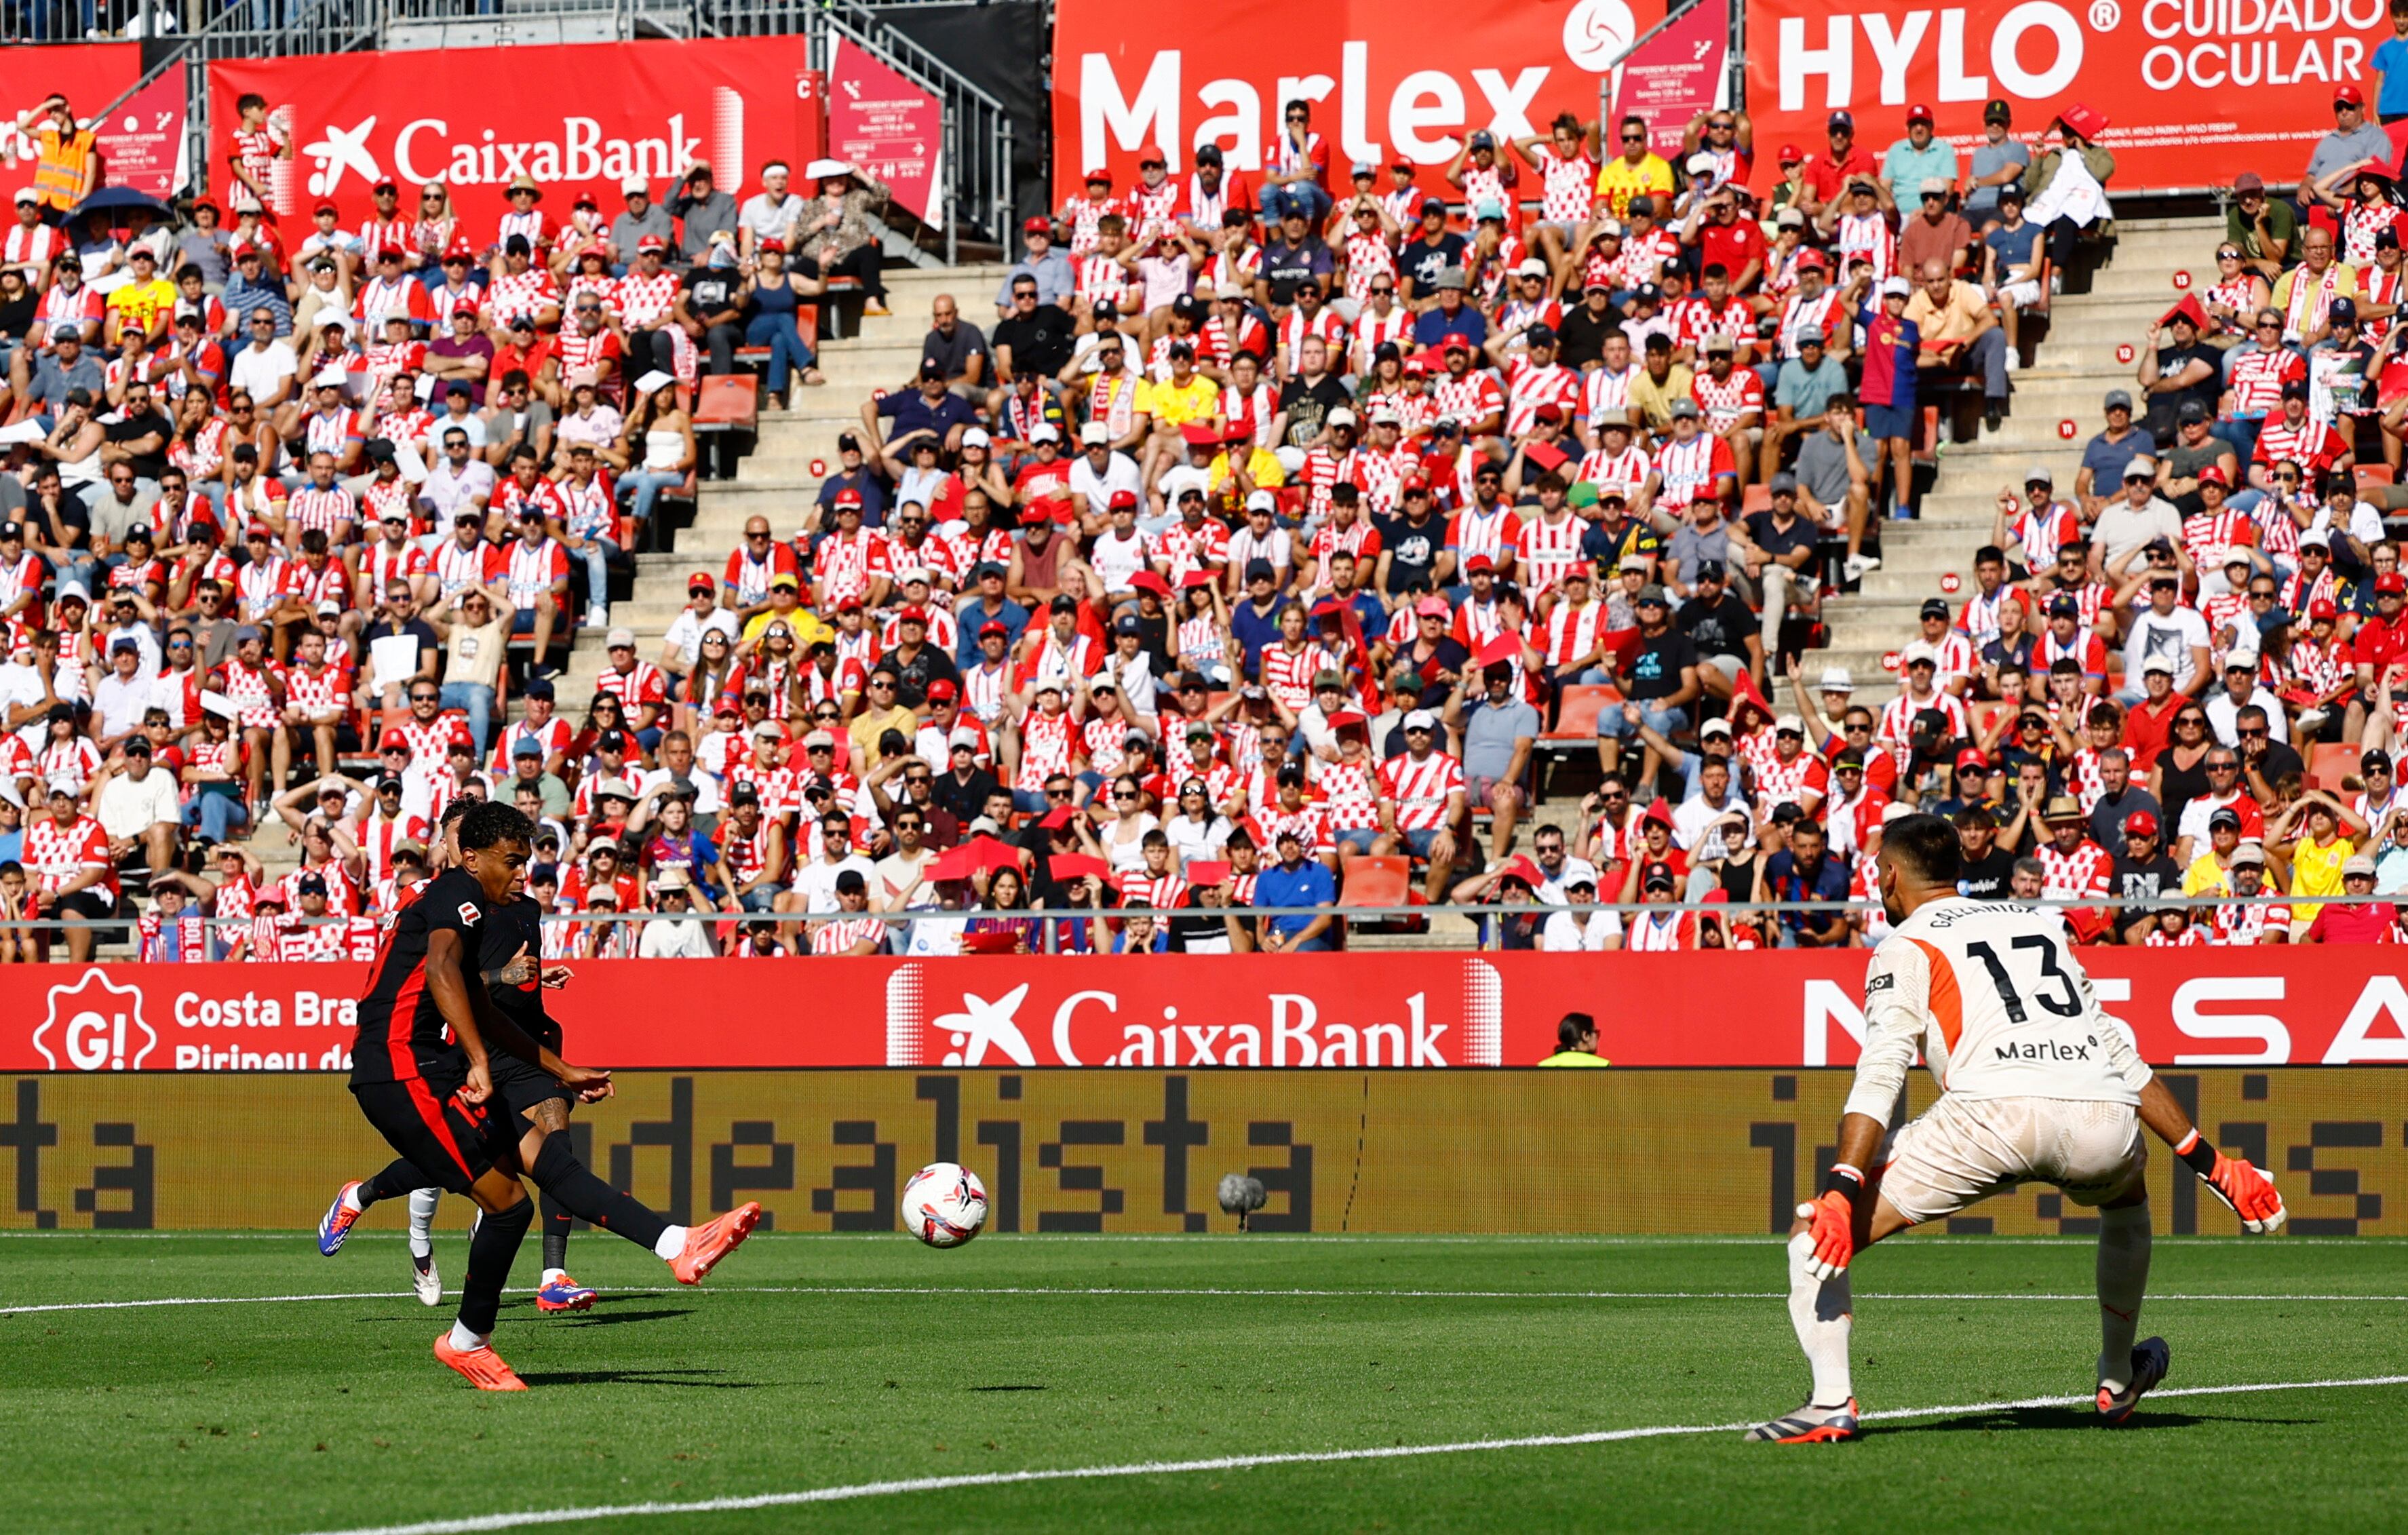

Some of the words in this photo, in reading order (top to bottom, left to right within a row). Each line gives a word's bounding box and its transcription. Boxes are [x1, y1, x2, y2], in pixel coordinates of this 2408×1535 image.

[2141, 0, 2384, 39] CUIDADO
[2141, 37, 2363, 91] OCULAR
[797, 79, 811, 99] C
[1081, 40, 1552, 178] Marlex
[394, 113, 703, 185] CaixaBank
[2200, 133, 2277, 144] contraindicaciones
[2278, 133, 2291, 141] en
[2175, 274, 2188, 286] 13
[2118, 347, 2131, 360] 12
[2061, 423, 2074, 435] 11
[1941, 577, 1959, 589] 09
[1966, 933, 2082, 1024] 13
[174, 991, 281, 1028] Costa
[294, 991, 358, 1027] Bra
[66, 1011, 126, 1070] G!
[1052, 990, 1448, 1067] CaixaBank
[1995, 1039, 2091, 1061] Marlex
